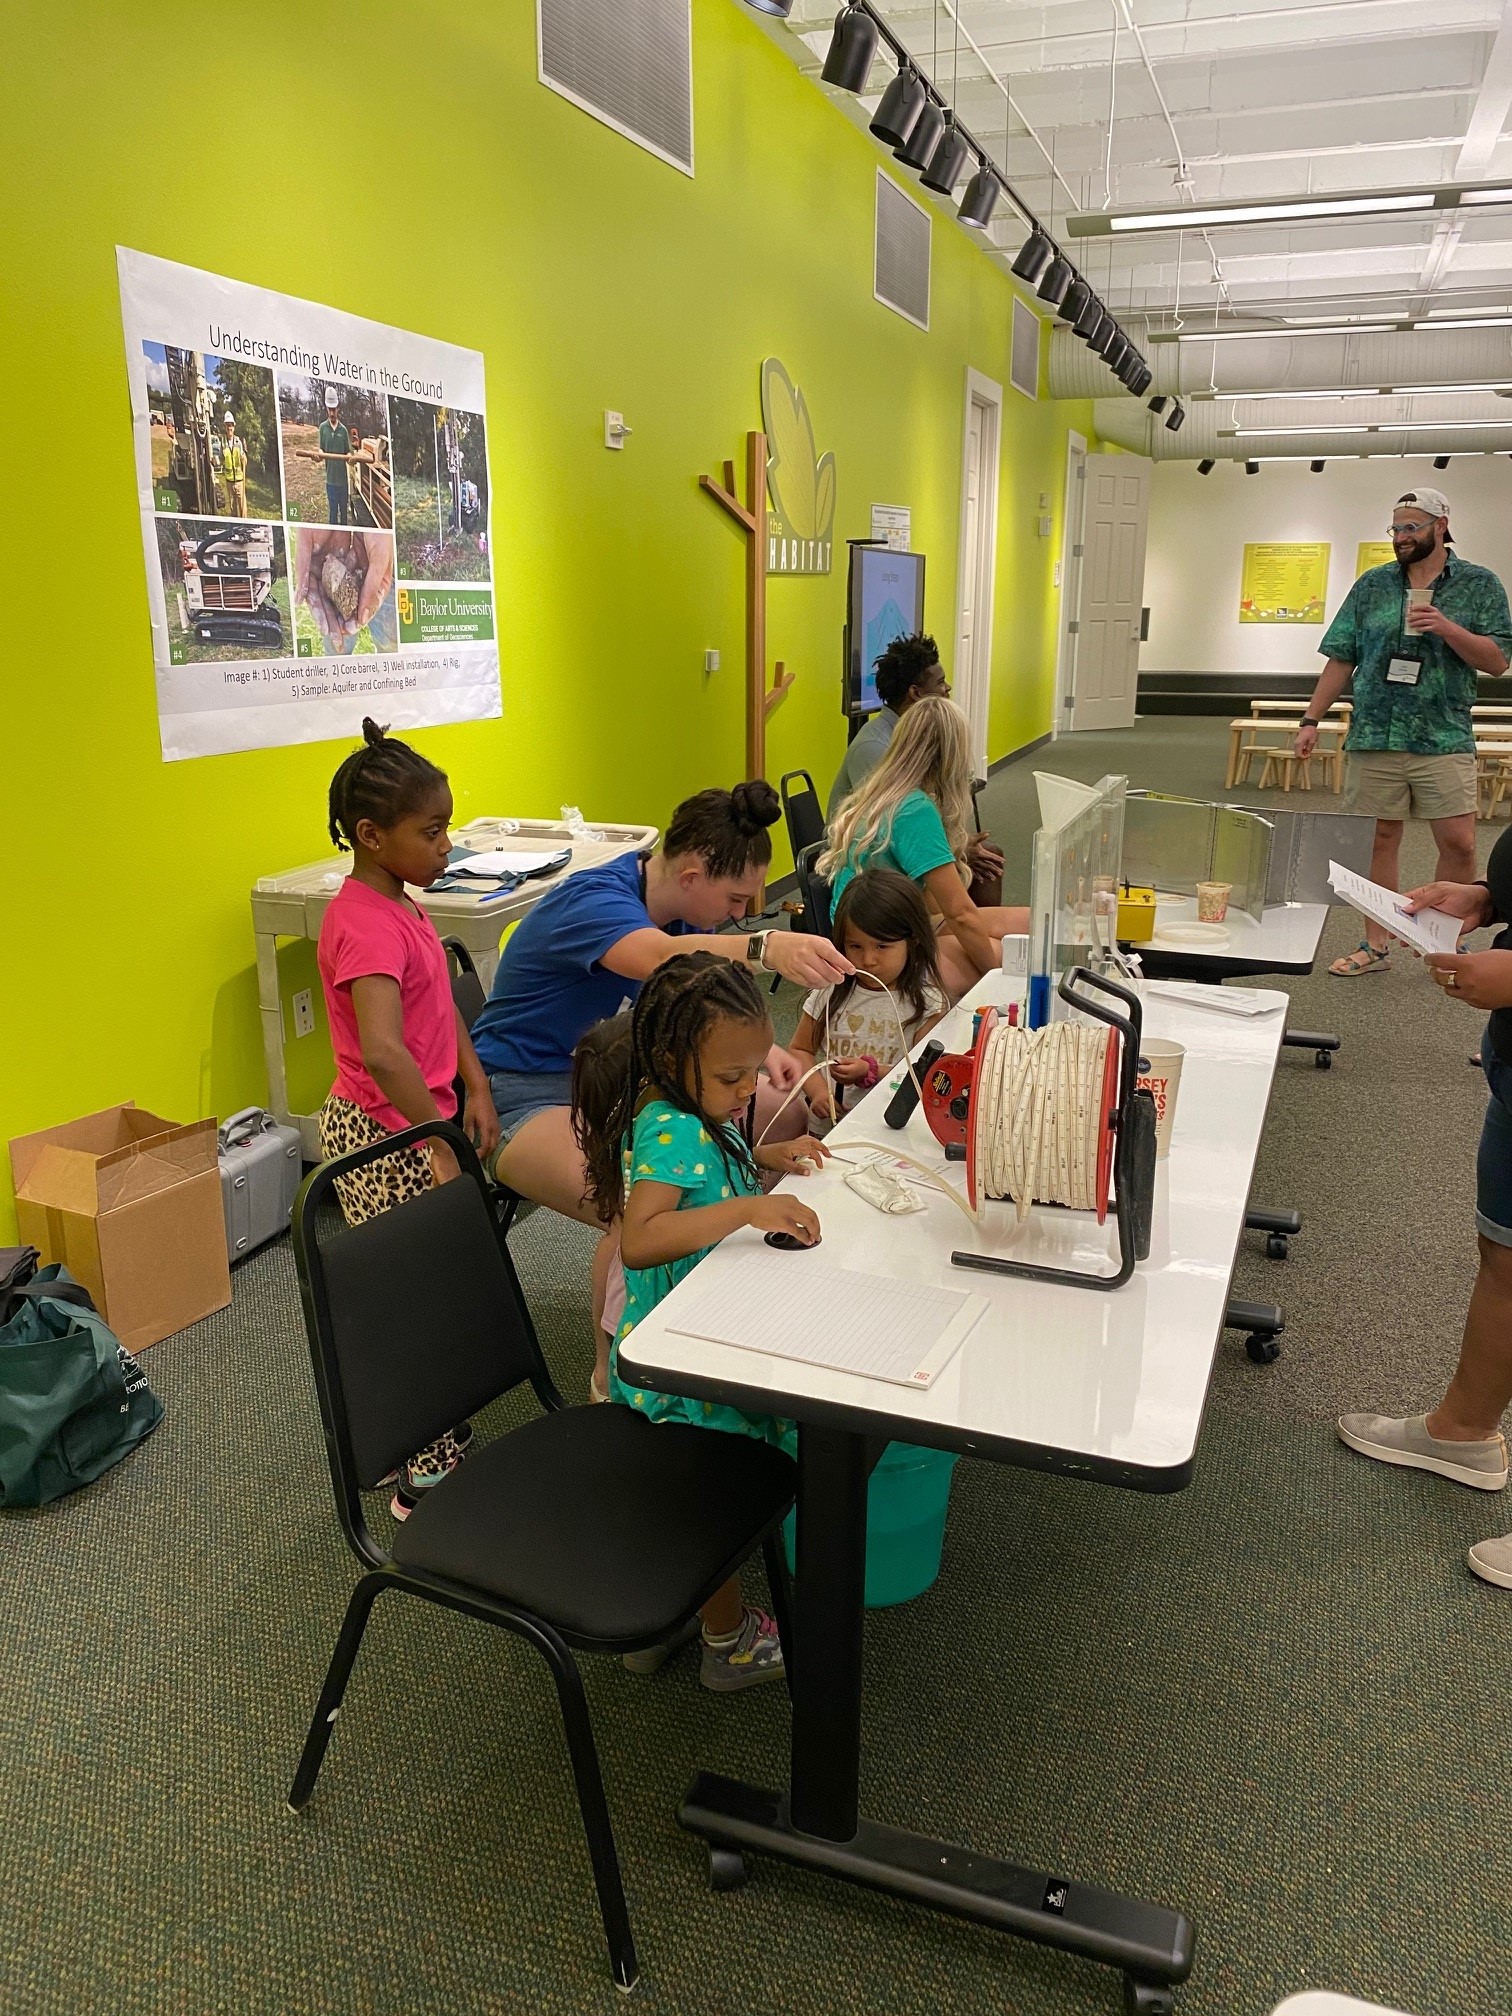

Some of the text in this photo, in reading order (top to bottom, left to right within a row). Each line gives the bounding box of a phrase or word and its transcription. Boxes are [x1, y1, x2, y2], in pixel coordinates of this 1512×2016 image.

[209, 324, 443, 400] Understanding Water in the Ground
[161, 496, 172, 507] #1
[289, 507, 298, 517] #2
[769, 517, 783, 535] the
[769, 537, 831, 571] HABITAT
[400, 567, 407, 576] #3
[420, 598, 493, 620] Baylor University
[421, 625, 439, 633] COLLEGE
[421, 634, 444, 642] Department
[301, 644, 308, 652] #5
[173, 651, 183, 660] #4
[224, 671, 251, 684] Image
[252, 670, 261, 680] #:
[262, 668, 271, 682] 1)
[272, 667, 304, 680] Student
[305, 664, 329, 678] driller,
[332, 664, 339, 677] 2)
[340, 663, 357, 675] Core
[358, 662, 380, 674] barrel,
[383, 661, 390, 673] 3)
[390, 659, 405, 671] Well
[405, 658, 440, 670] installation,
[443, 658, 449, 669] 4)
[291, 676, 417, 699] 5) Sample: Aquifer and Confining Bed
[829, 1038, 900, 1064] MOMMY
